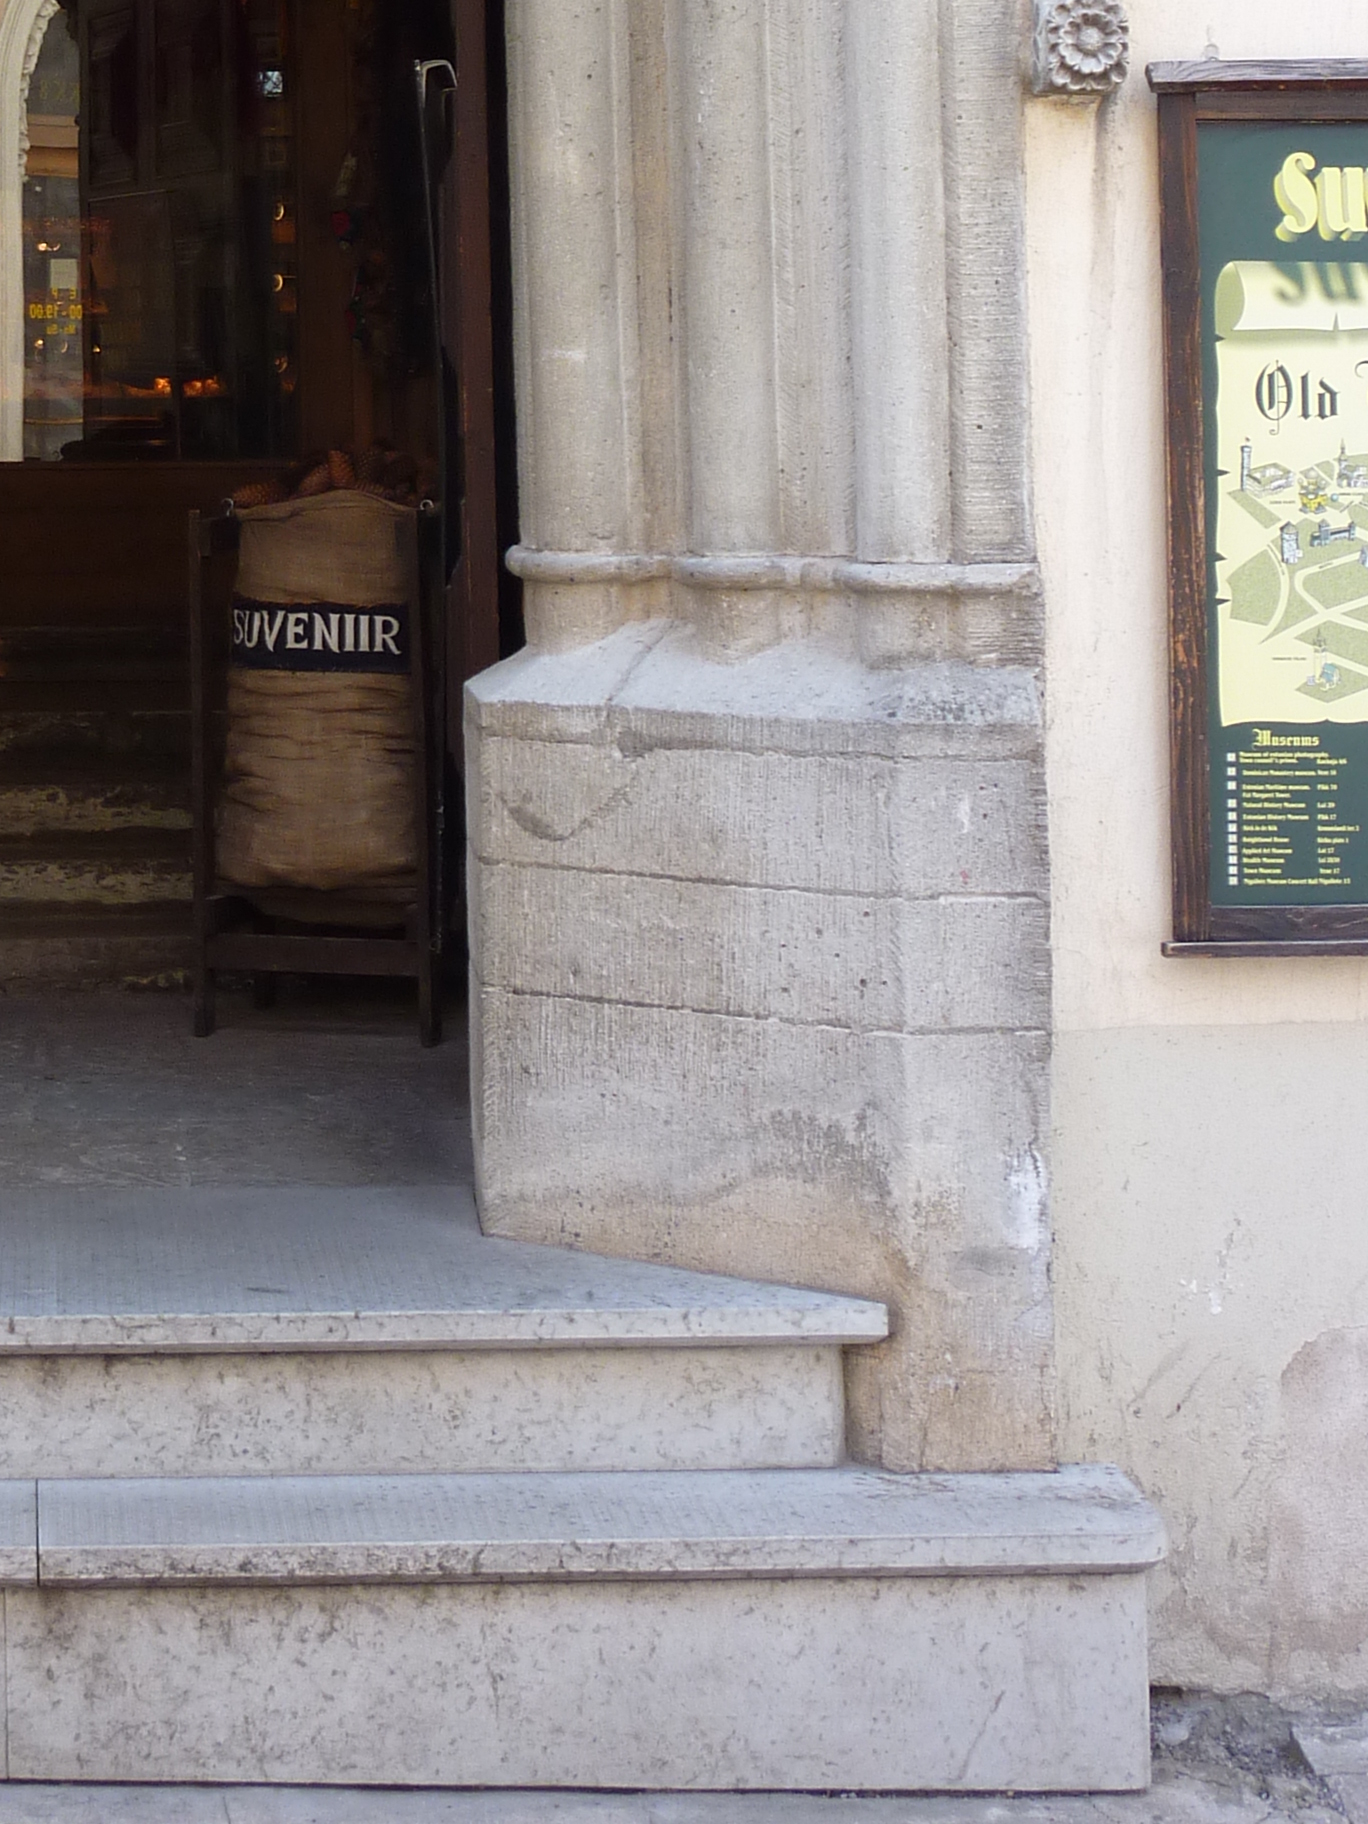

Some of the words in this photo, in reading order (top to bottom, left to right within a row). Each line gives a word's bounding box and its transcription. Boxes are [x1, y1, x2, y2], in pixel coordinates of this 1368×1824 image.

[1255, 359, 1341, 436] Old
[232, 608, 403, 655] SUVENIIR
[1252, 728, 1320, 750] Museums
